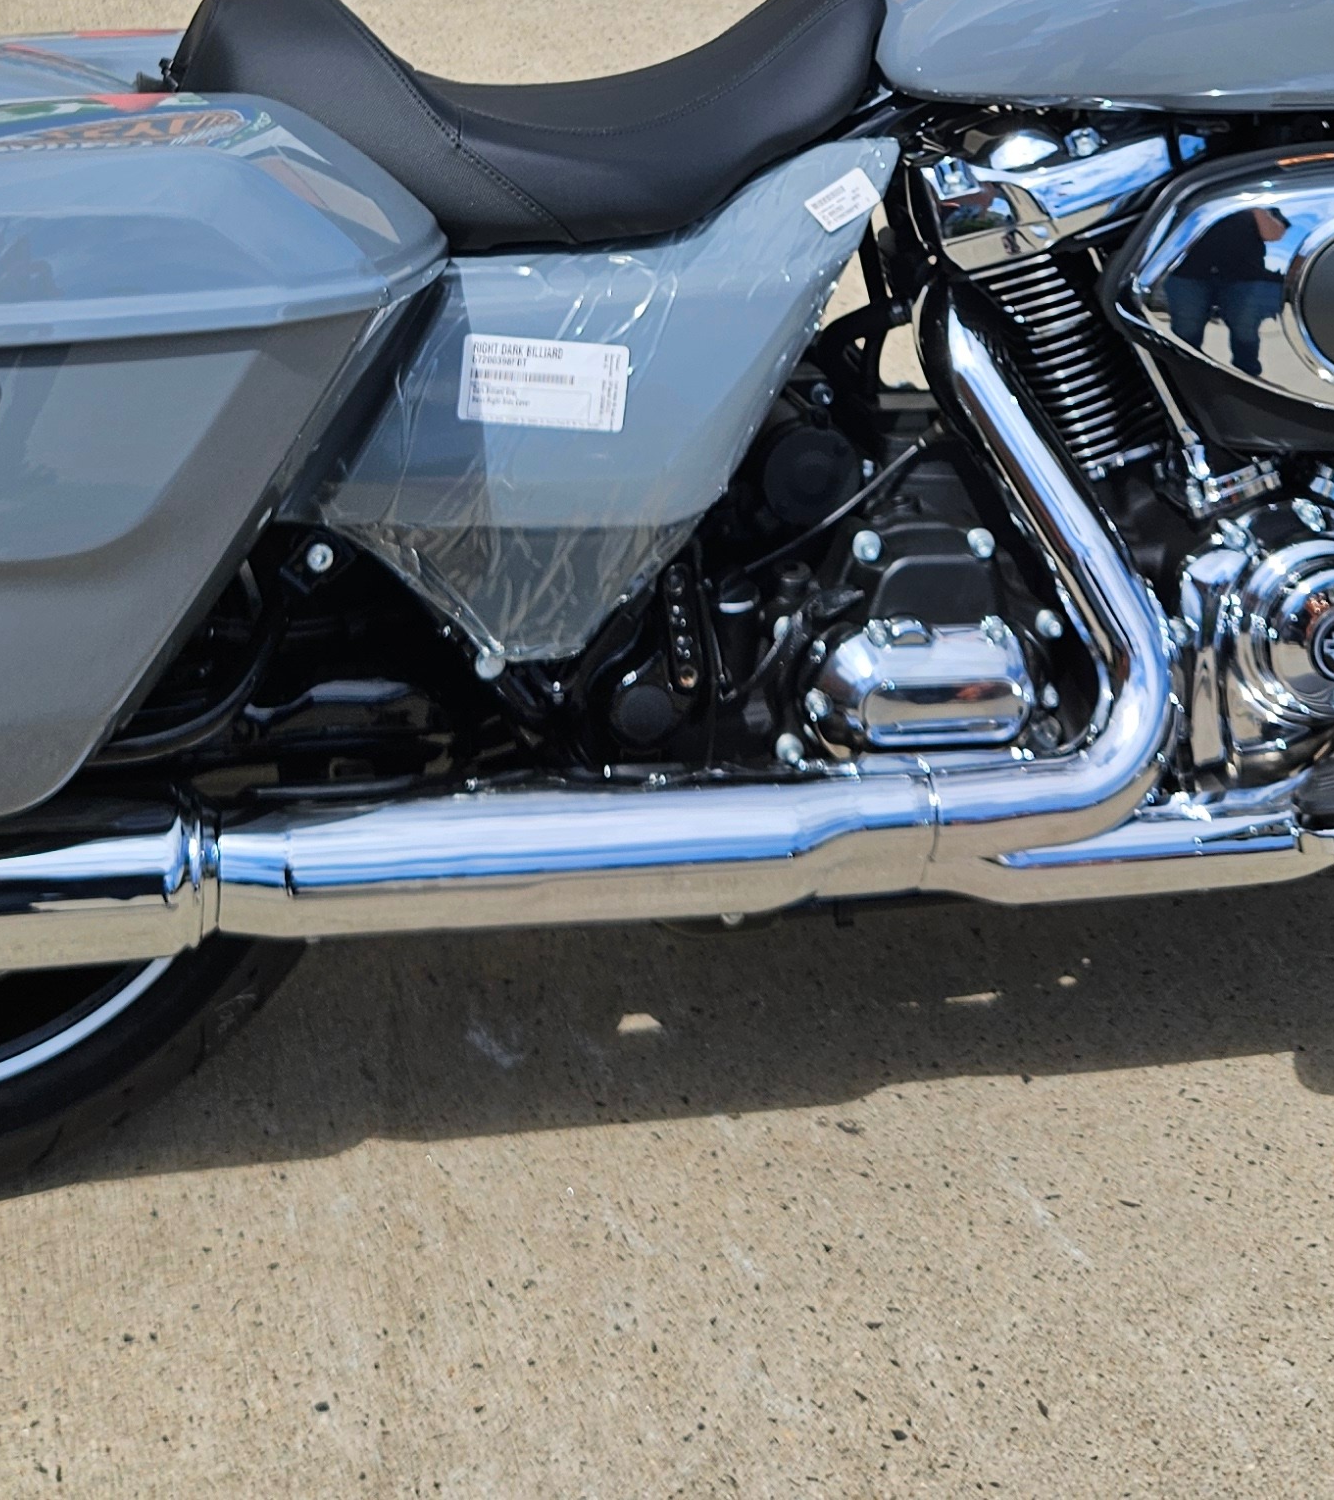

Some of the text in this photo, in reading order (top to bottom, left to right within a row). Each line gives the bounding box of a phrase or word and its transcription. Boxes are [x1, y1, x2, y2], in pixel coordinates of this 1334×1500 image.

[473, 342, 564, 360] RIGHT DARK BILLIARD
